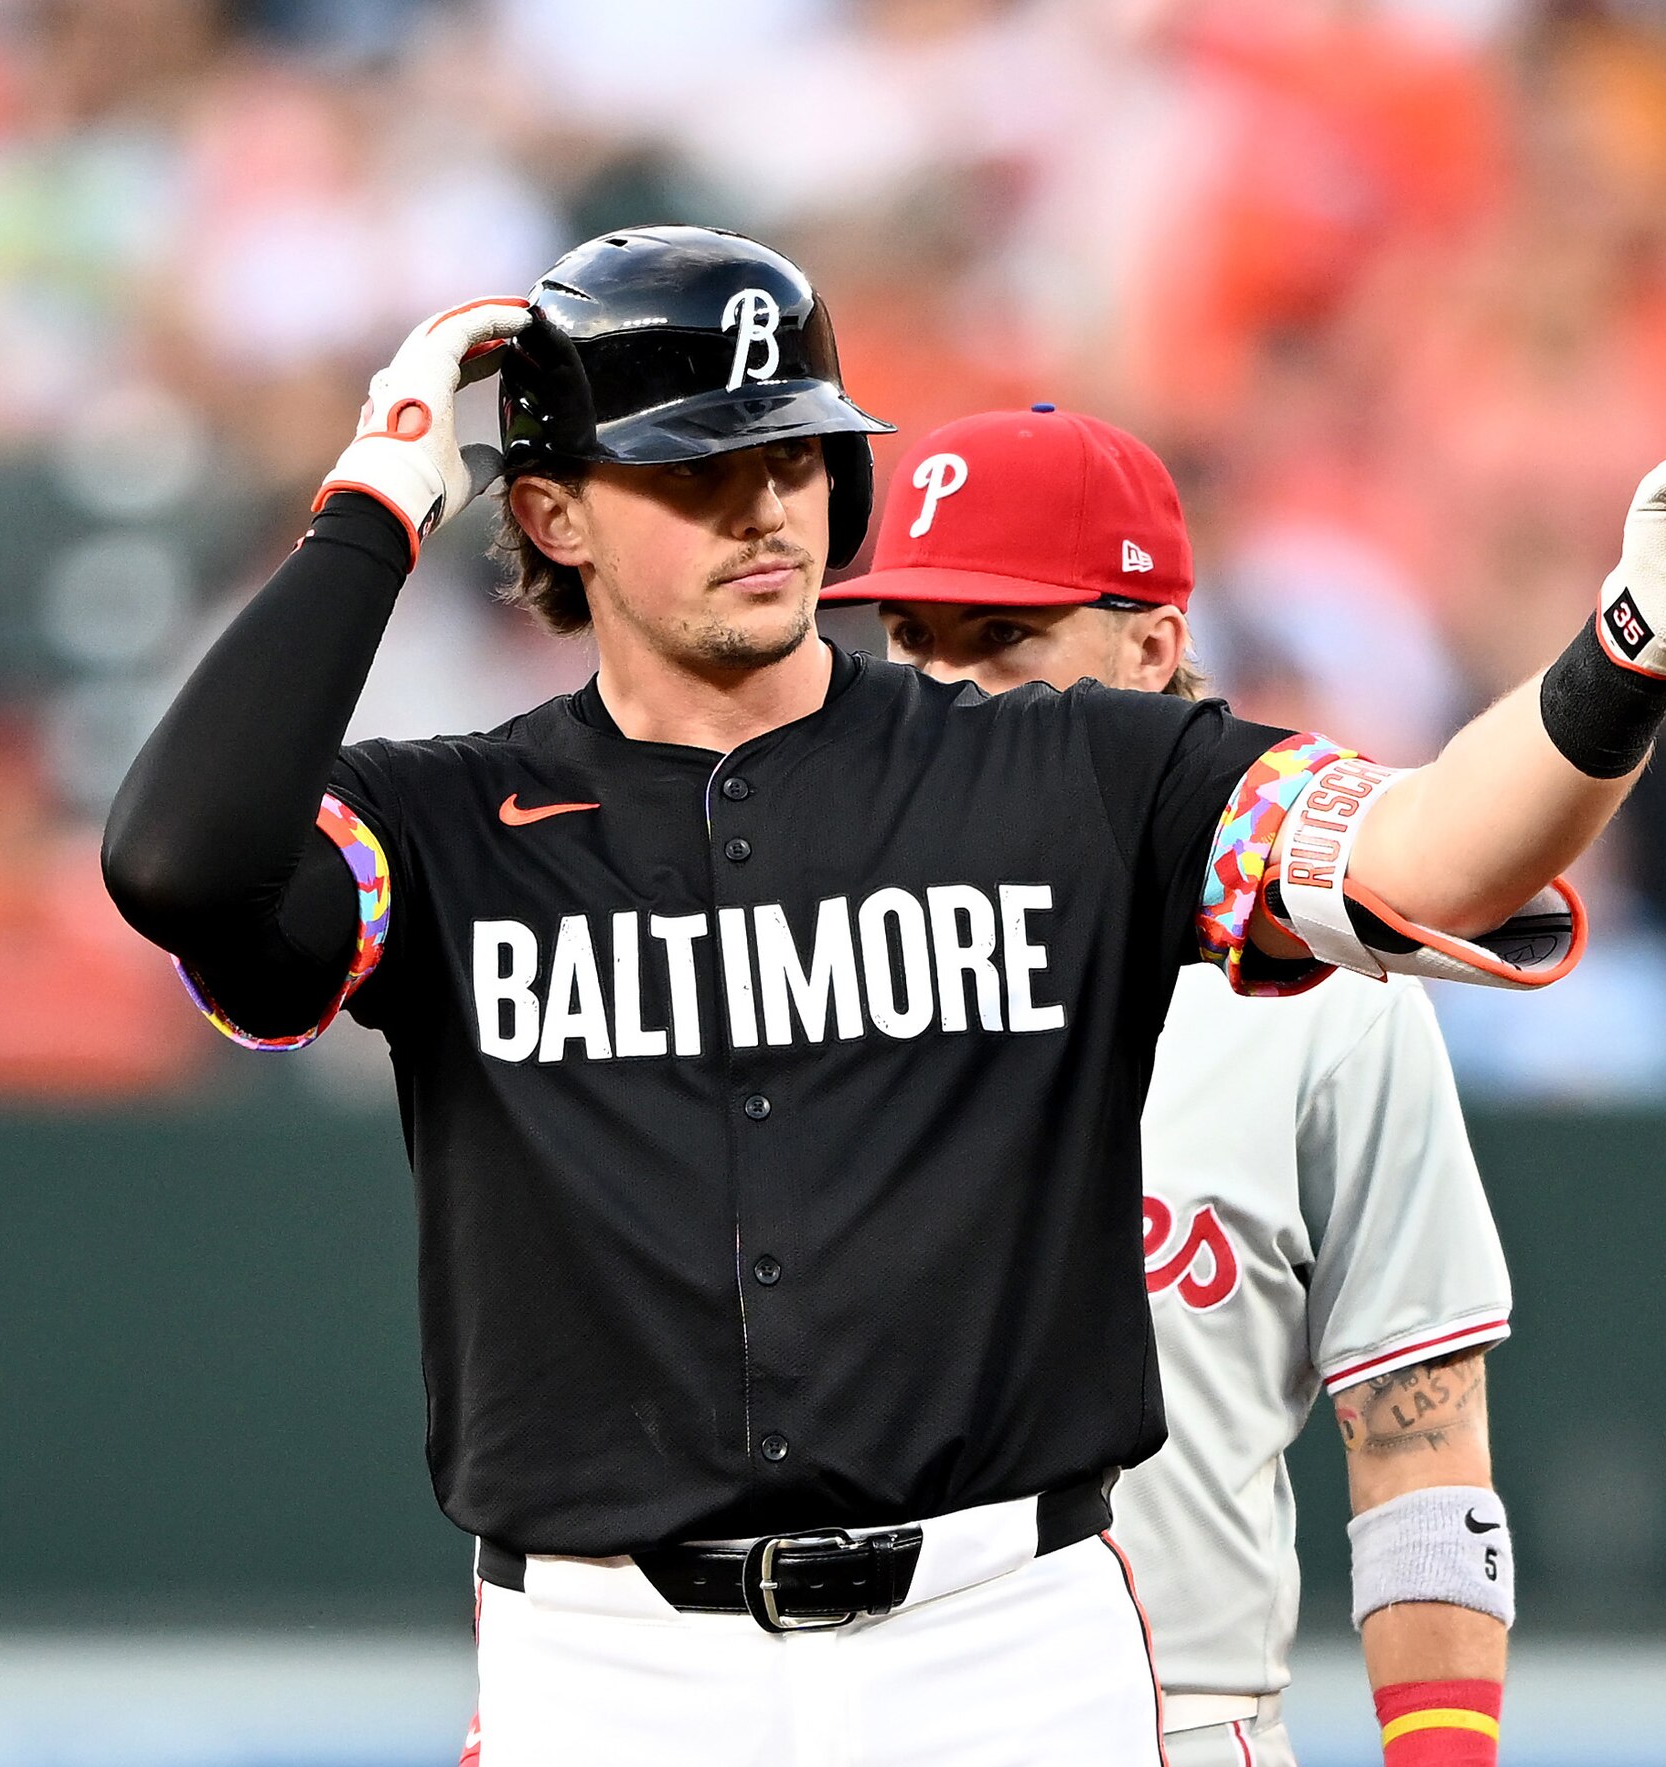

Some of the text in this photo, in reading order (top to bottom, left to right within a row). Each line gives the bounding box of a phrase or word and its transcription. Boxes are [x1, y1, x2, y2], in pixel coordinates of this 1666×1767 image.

[721, 288, 780, 391] B
[910, 452, 969, 539] P
[1613, 601, 1645, 645] 35
[472, 884, 1065, 1064] BALTIMORE
[1484, 1547, 1498, 1581] 5
